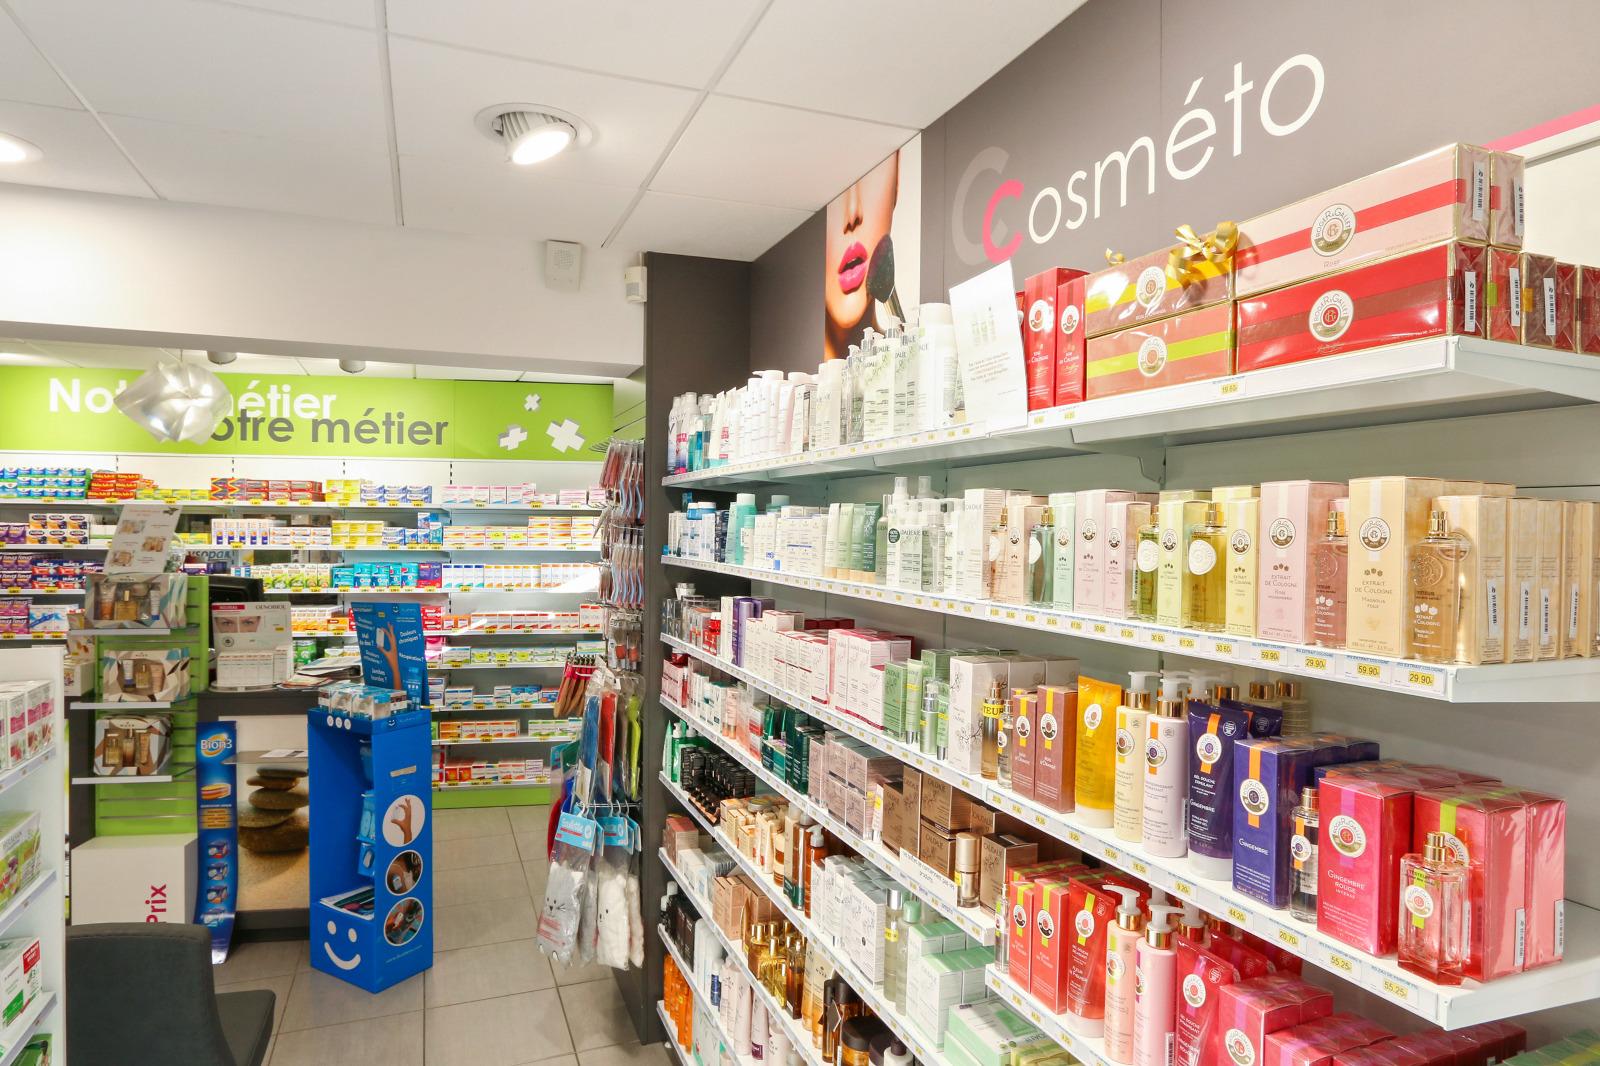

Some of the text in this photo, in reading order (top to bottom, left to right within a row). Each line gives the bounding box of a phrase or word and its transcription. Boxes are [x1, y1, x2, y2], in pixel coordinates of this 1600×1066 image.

[229, 379, 338, 419] étier
[210, 407, 449, 446] otre métier
